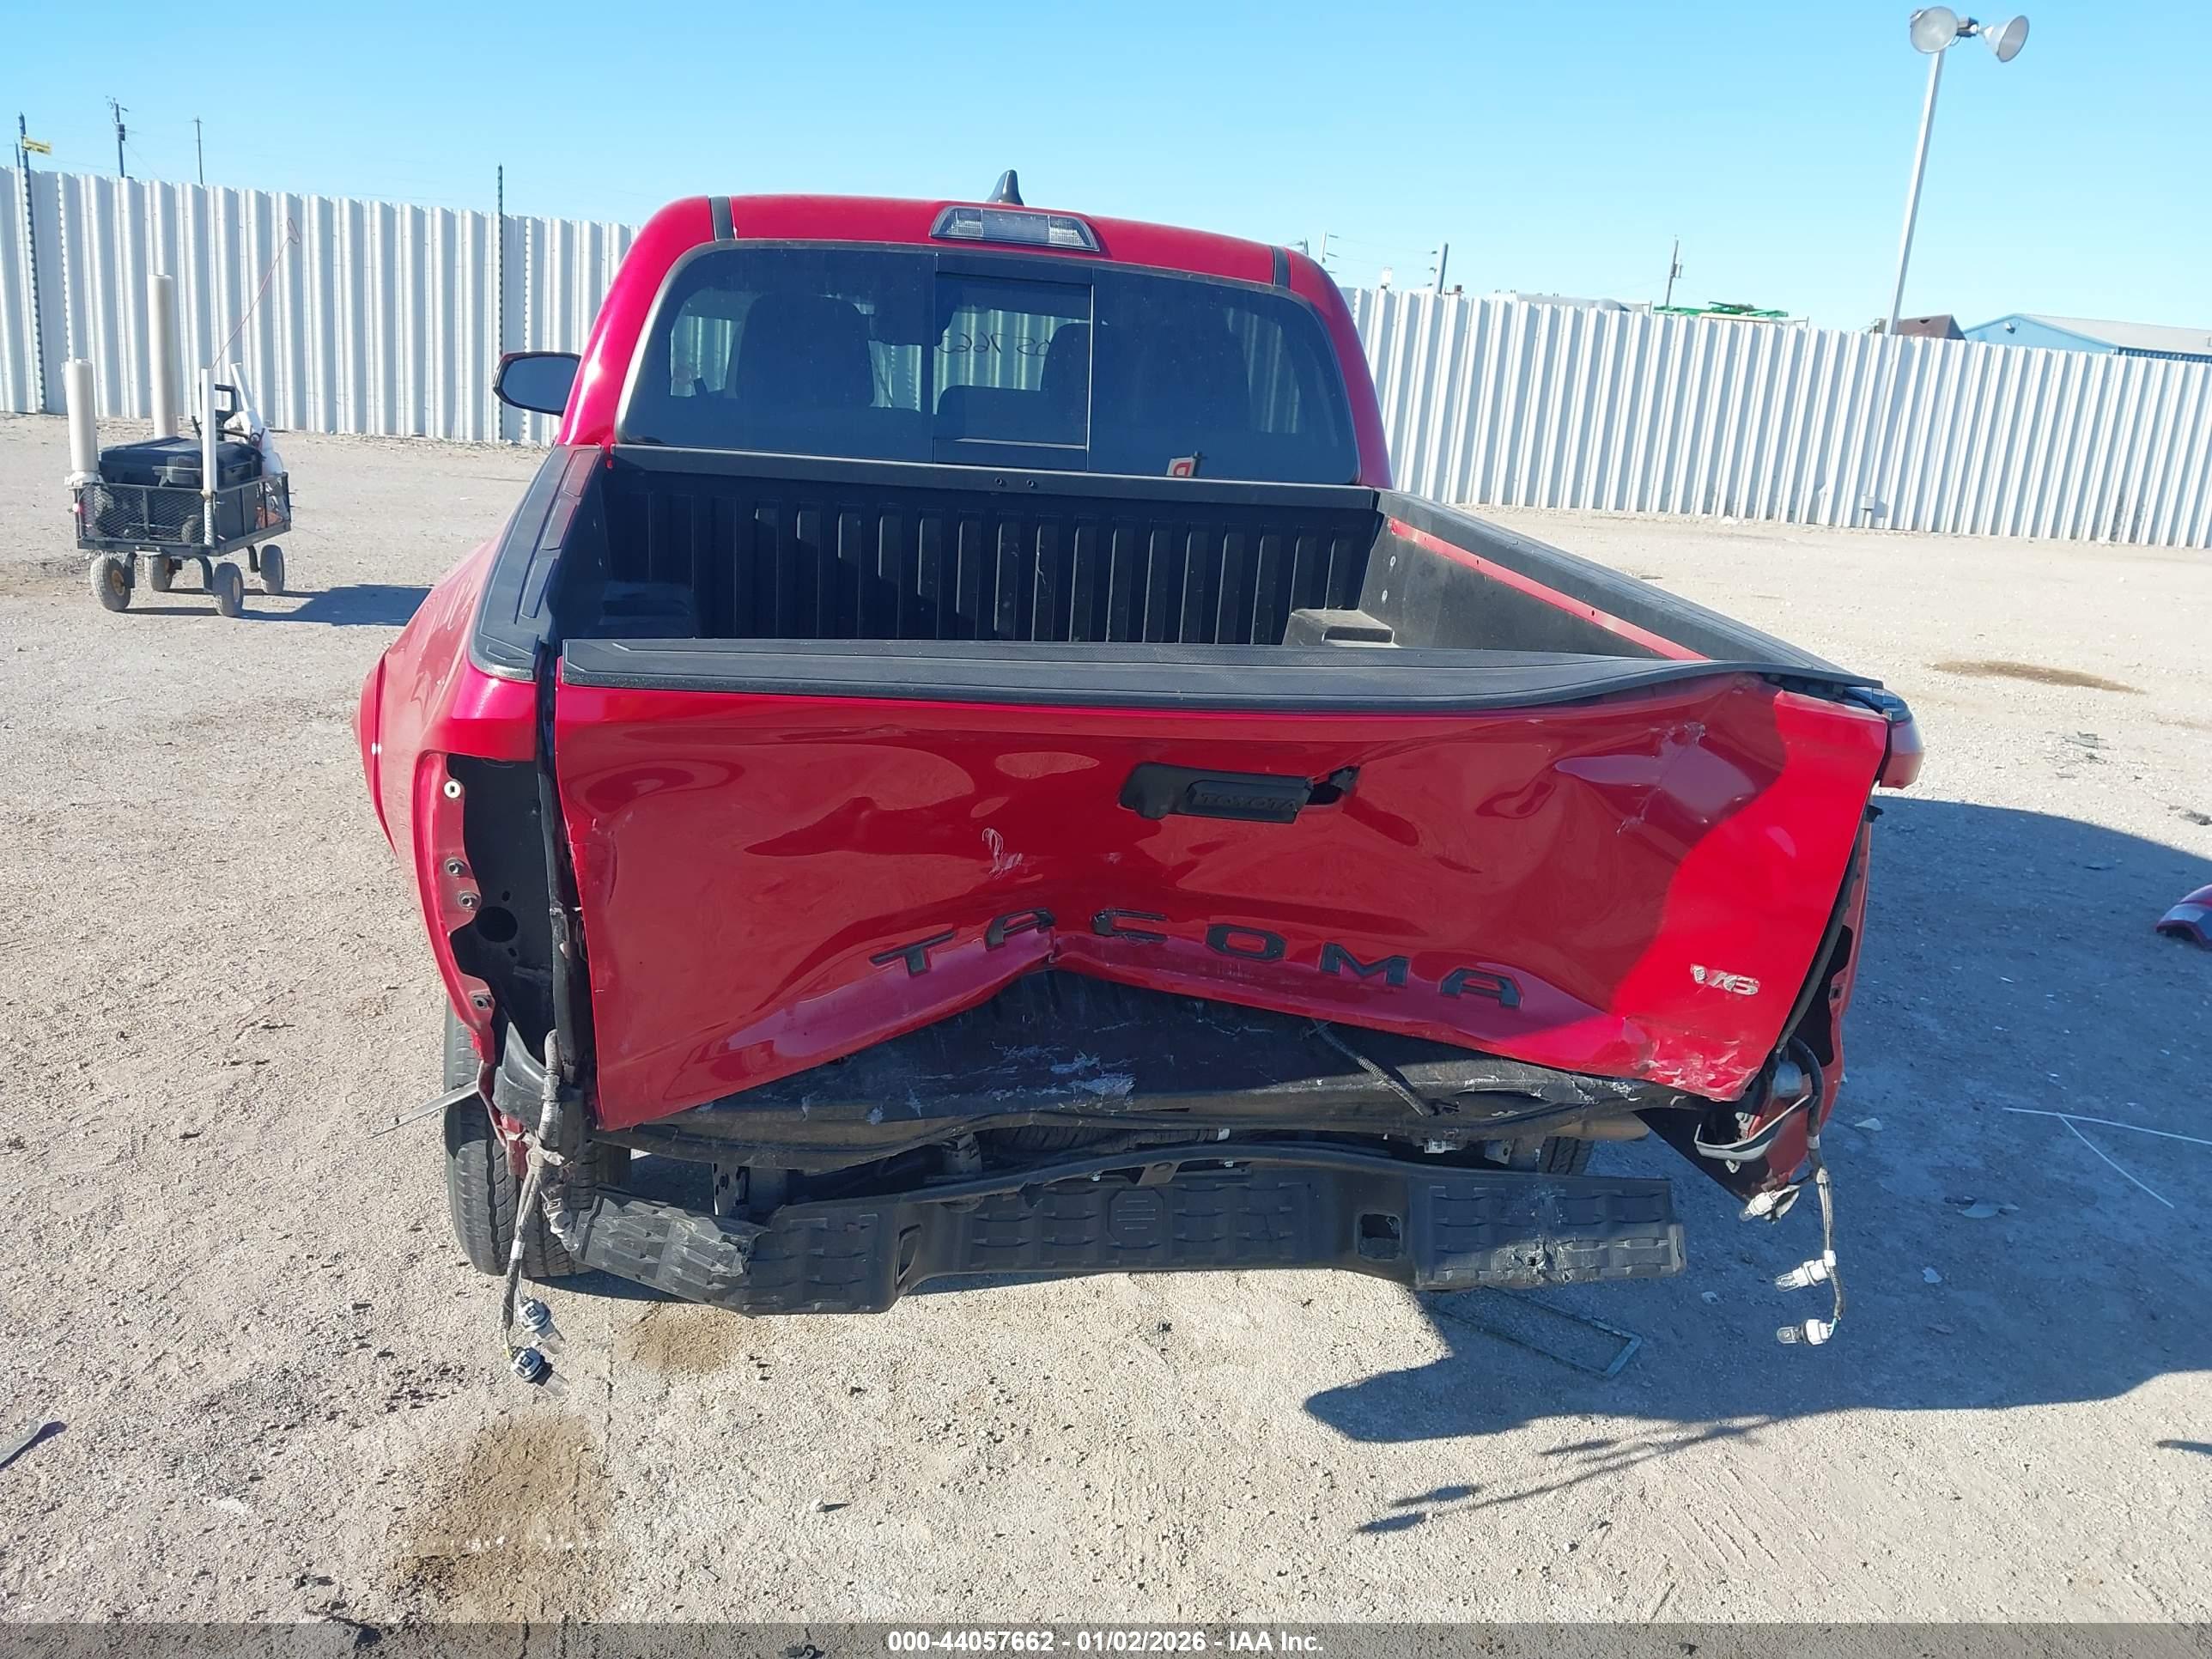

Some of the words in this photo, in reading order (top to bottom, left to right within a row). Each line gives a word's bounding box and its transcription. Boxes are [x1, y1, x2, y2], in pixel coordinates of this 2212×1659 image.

[1200, 792, 1297, 812] TOYOTA
[869, 907, 1525, 1008] TACOMA
[1690, 963, 1759, 995] V6
